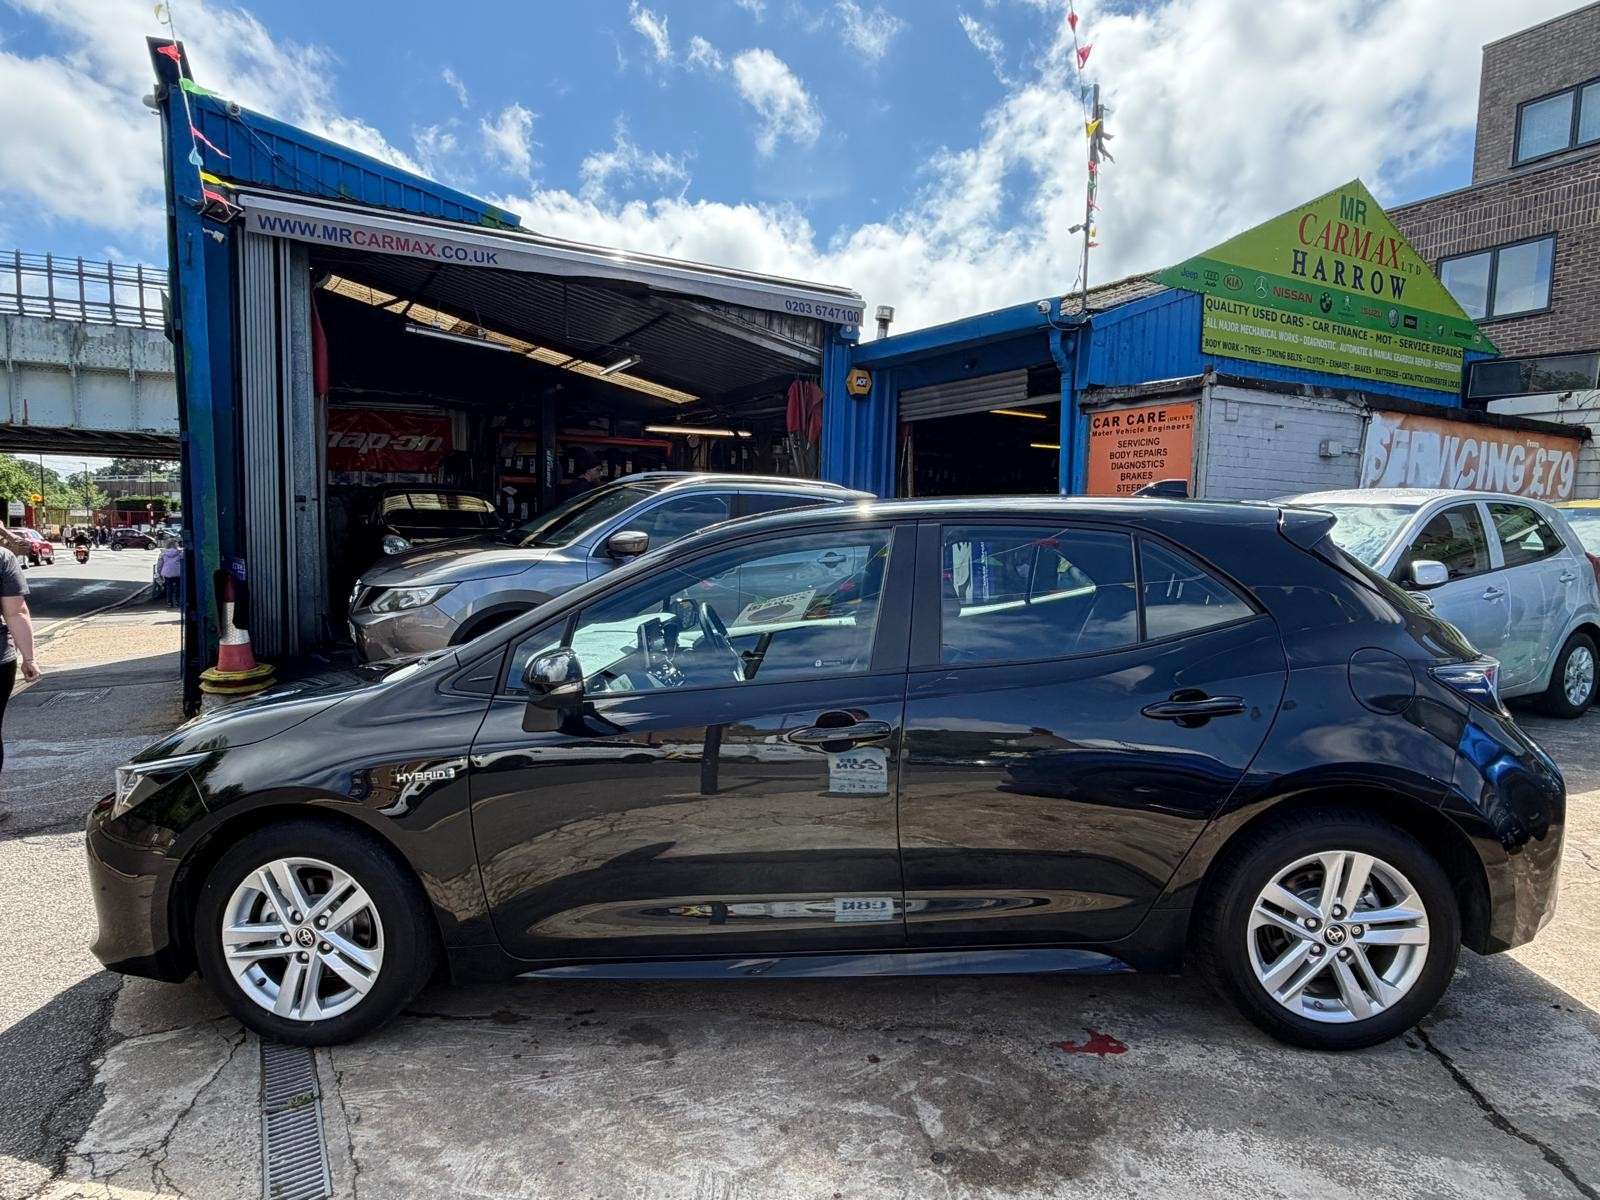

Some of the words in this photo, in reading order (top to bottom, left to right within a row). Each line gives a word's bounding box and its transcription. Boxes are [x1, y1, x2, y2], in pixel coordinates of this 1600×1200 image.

[1340, 194, 1367, 225] MR
[257, 214, 498, 265] WWW.MRCARMAX.CO.UK
[1299, 213, 1404, 269] CARMAX
[1401, 261, 1421, 275] LTD
[1226, 277, 1240, 288] KIA
[1291, 248, 1406, 299] HARROW
[1273, 287, 1312, 304] NISSAN
[785, 300, 812, 314] 0203
[815, 305, 860, 323] 6747100
[1205, 317, 1218, 329] ALL
[1219, 319, 1240, 333] MAJOR
[1240, 324, 1278, 340] MECHANICAL
[1278, 331, 1300, 344] WORKS
[1206, 298, 1250, 316] QUALITY
[1252, 307, 1278, 322] USED
[1280, 313, 1304, 328] CARS
[1312, 320, 1330, 333] CAR
[1332, 325, 1368, 341] FINANCE
[1376, 333, 1393, 345] MOT
[1399, 338, 1431, 353] SERVICE
[1432, 345, 1462, 359] REPAIRS
[1204, 338, 1222, 348] BODY
[1222, 340, 1239, 352] WORK
[1244, 344, 1262, 356] TYRES
[1266, 348, 1287, 360] TIMING
[1286, 351, 1303, 362] BELTS
[1306, 355, 1326, 366] CLUTCH
[1329, 359, 1350, 371] EXHAUST
[1354, 363, 1372, 374] BRAKES
[1093, 416, 1120, 429] CAR
[1126, 411, 1167, 425] CARE
[1115, 427, 1145, 435] Vehicle
[1147, 423, 1191, 433] Engineers
[327, 431, 444, 455] nap-on
[1109, 450, 1131, 460] BODY
[1133, 448, 1168, 458] REPAIRS
[1117, 437, 1160, 448] SERVICING
[1111, 460, 1165, 470] DIAGNOSTICS
[1120, 471, 1153, 481] BRAKES
[1529, 447, 1574, 498] £79
[396, 770, 445, 783] HYBRID
